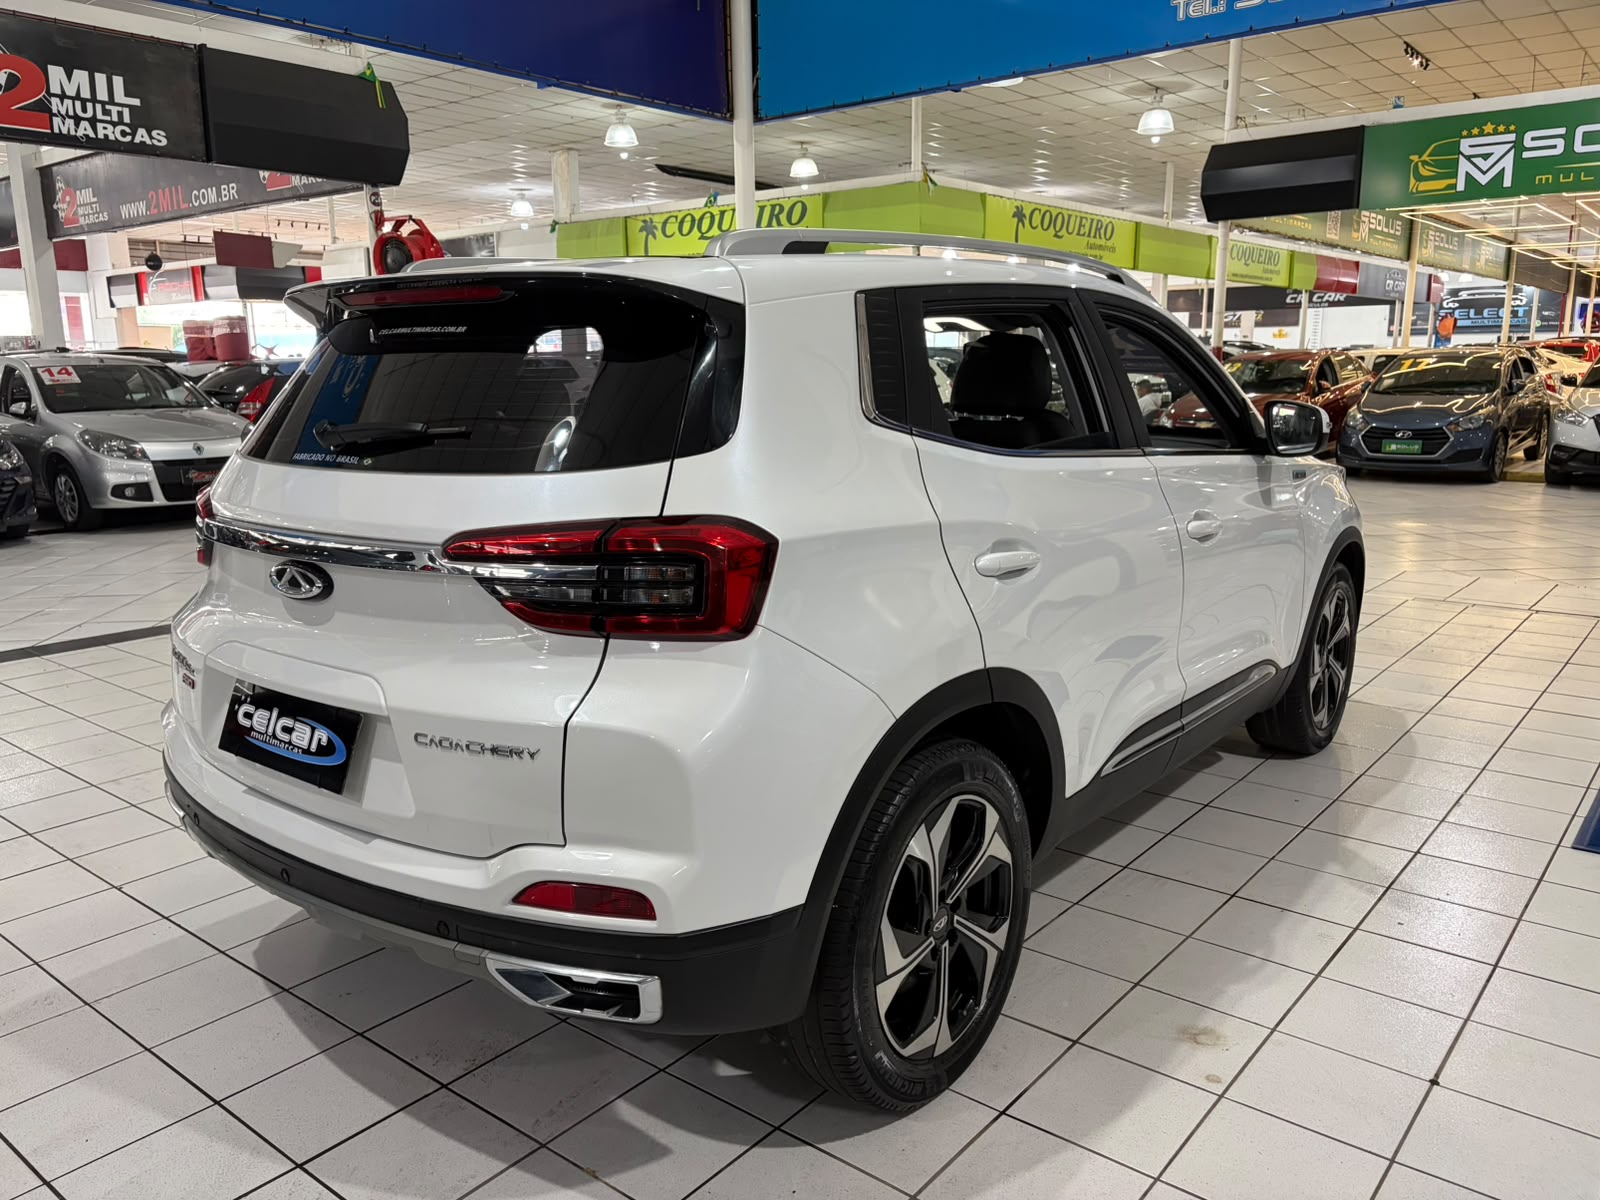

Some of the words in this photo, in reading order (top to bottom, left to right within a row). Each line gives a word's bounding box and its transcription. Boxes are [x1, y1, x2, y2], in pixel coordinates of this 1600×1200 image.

[47, 64, 141, 106] MIL
[51, 97, 131, 124] MULTI
[52, 116, 168, 147] MARCAS
[61, 187, 81, 228] 2
[76, 187, 97, 206] MIL
[78, 203, 100, 215] MULTI
[120, 183, 238, 220] WWW.2MIL.COM.BR
[80, 212, 109, 225] MARCAS
[660, 199, 808, 241] COQUIRO
[1028, 207, 1116, 242] COQUEIRO
[1369, 212, 1402, 237] SOLUS
[1434, 232, 1459, 251] SOLUS
[1230, 243, 1280, 267] COQUEIRO
[1312, 292, 1347, 302] CAR
[41, 367, 74, 378] 14
[292, 452, 325, 462] FABRICADO
[324, 454, 336, 462] NO
[336, 454, 360, 465] BRASIL
[236, 703, 329, 753] celcar
[250, 730, 303, 755] multimarcas
